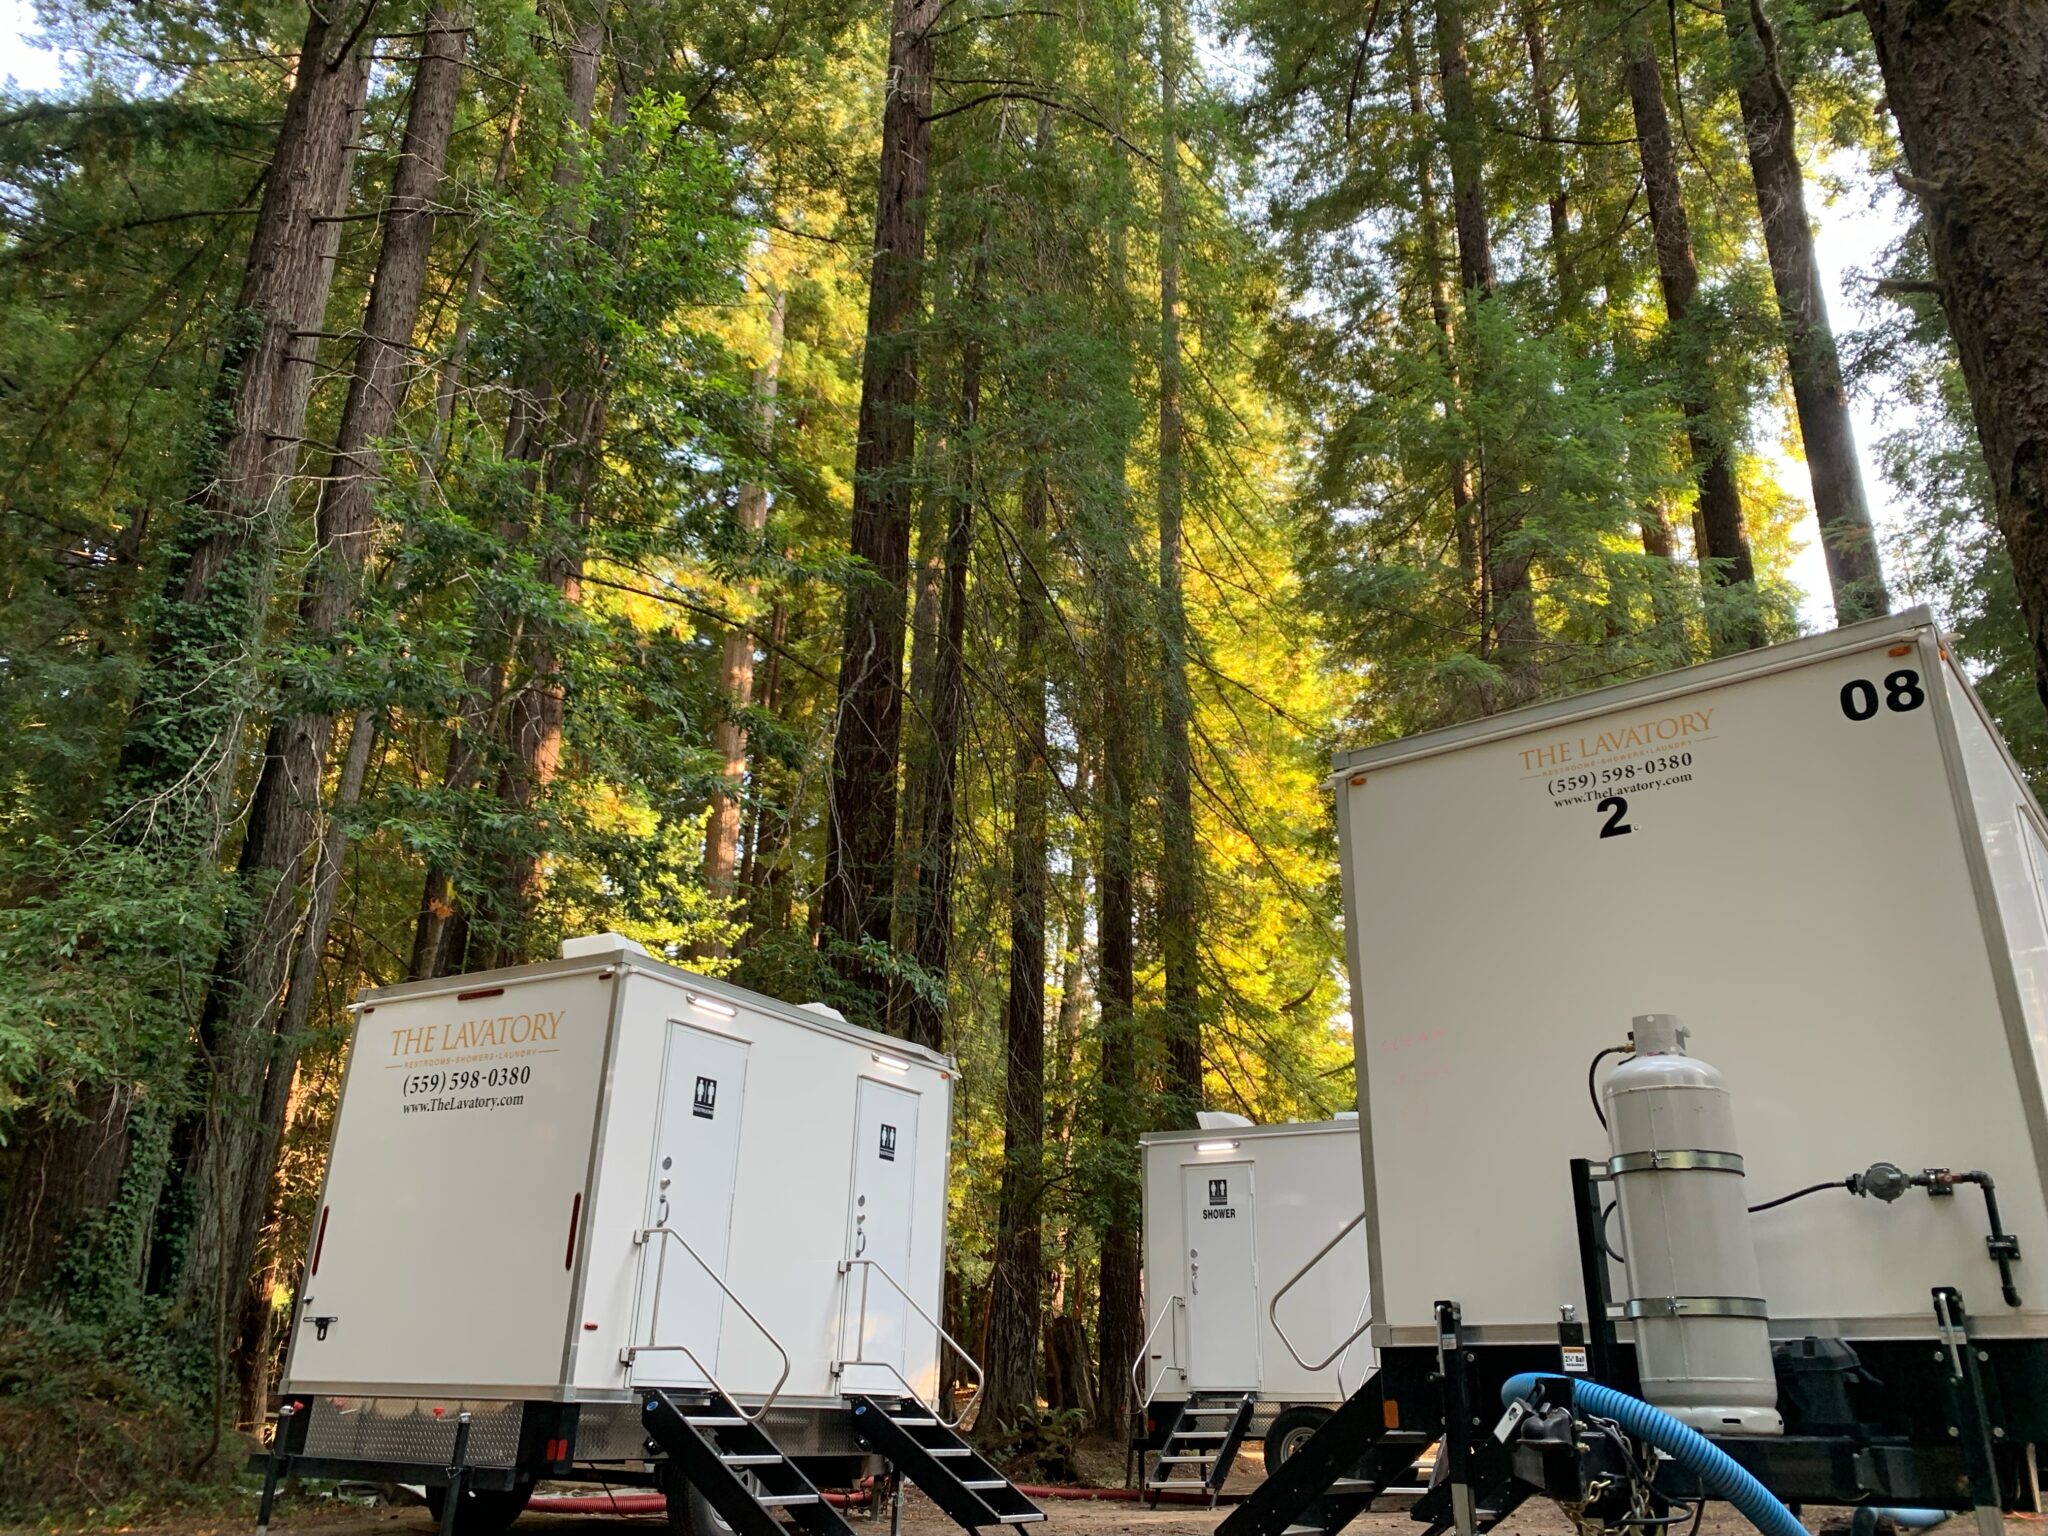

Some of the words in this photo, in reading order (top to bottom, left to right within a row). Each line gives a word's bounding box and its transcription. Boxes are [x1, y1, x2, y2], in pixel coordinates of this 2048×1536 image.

[1840, 669, 1925, 721] 08
[1518, 742, 1573, 771] THE
[1579, 708, 1715, 758] LAVATORY
[1548, 771, 1597, 796] (559)
[1602, 752, 1693, 784] 598-0380
[1553, 772, 1693, 808] www.TheLavatory.com
[1596, 796, 1632, 839] 2
[392, 1025, 437, 1056] THE
[440, 1010, 566, 1051] LAVATORY
[403, 1071, 446, 1097] (559)
[449, 1065, 531, 1091] 598-0380
[403, 1094, 524, 1114] www.TheLavatory.com
[1202, 1208, 1236, 1220] SHOWER
